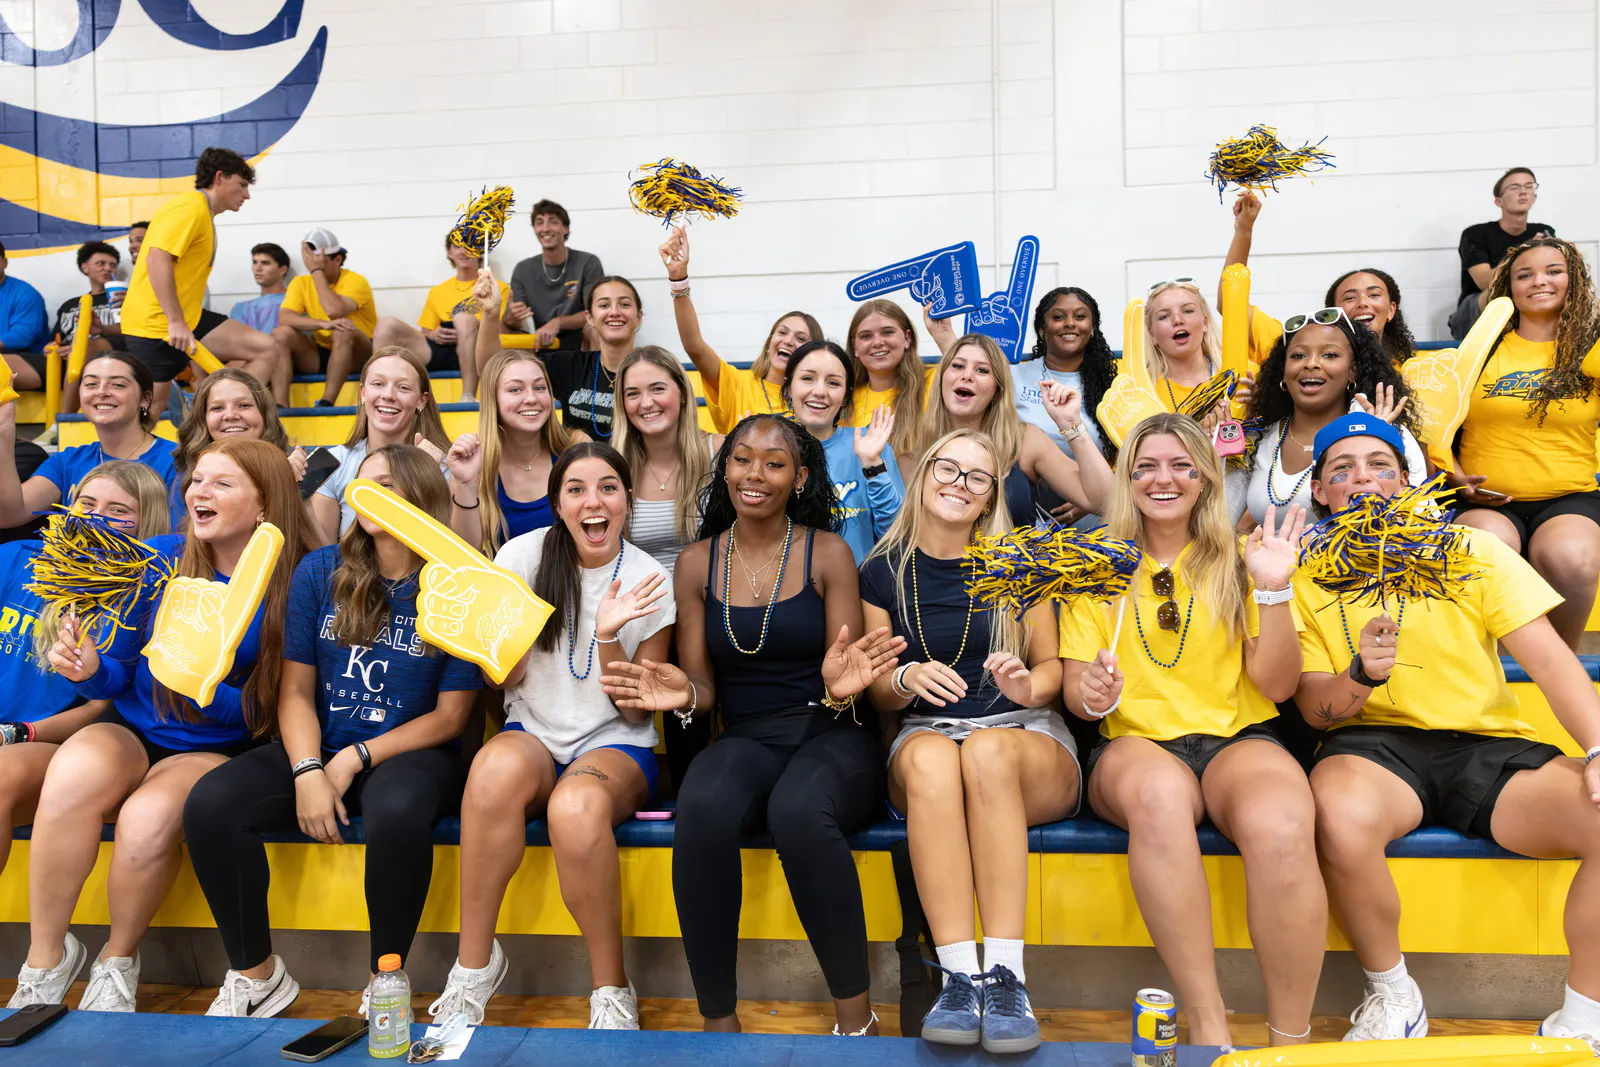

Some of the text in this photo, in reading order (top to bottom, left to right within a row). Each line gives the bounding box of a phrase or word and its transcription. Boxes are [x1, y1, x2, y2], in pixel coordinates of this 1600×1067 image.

[892, 272, 907, 281] ONE
[1016, 281, 1024, 295] ONE
[395, 615, 417, 627] CIT
[320, 615, 426, 657] RALS
[341, 643, 389, 693] KC
[325, 682, 403, 708] BSEBALL
